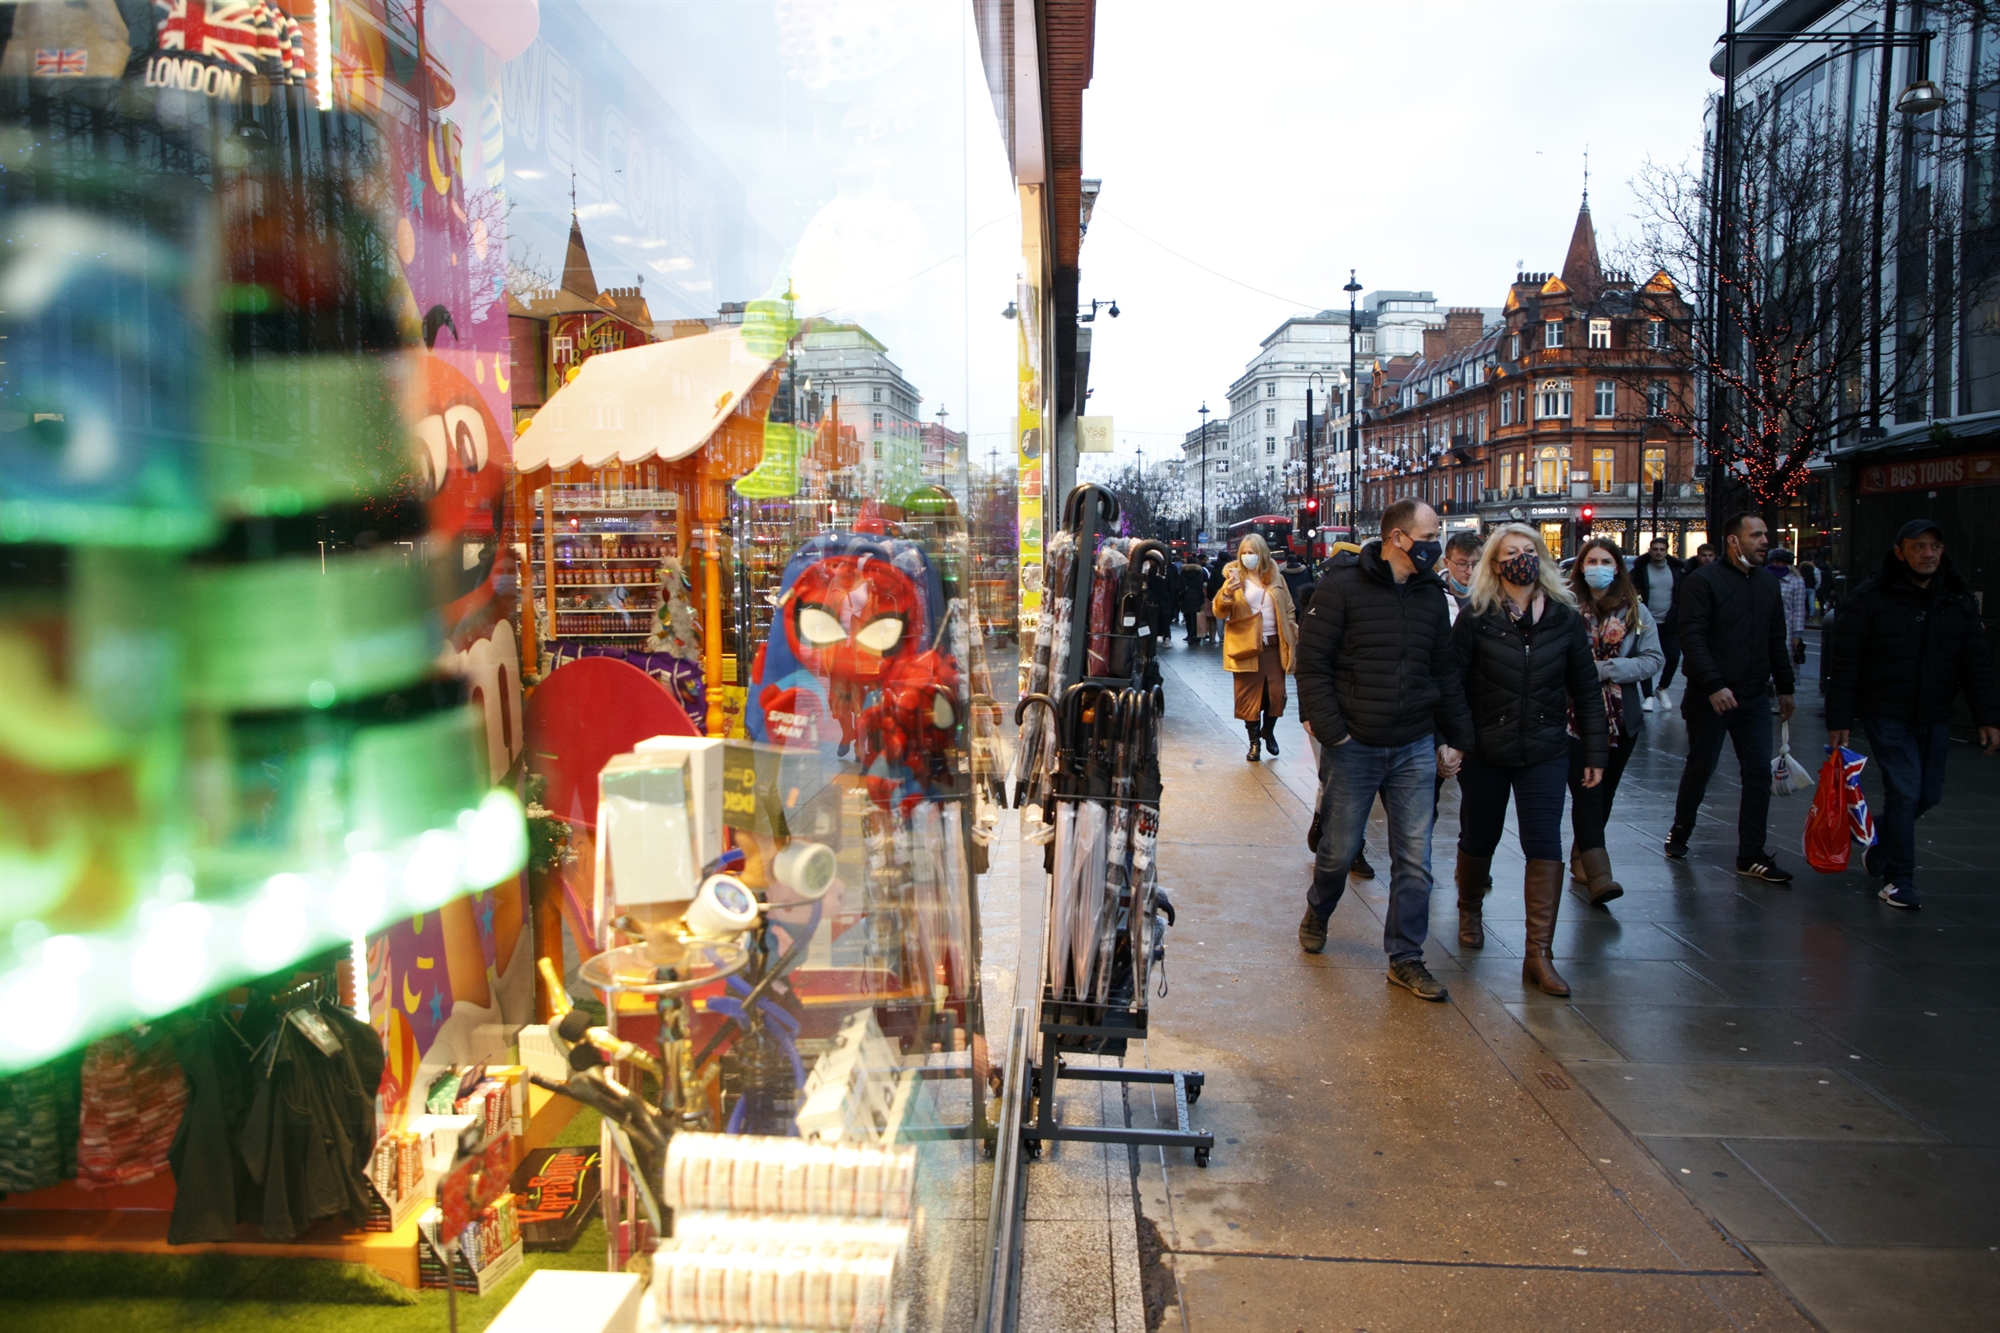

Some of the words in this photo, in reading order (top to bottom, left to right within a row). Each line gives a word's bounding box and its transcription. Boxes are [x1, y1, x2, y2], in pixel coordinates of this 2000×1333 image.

[144, 55, 243, 103] LONDON
[577, 315, 626, 352] Jelly
[1891, 464, 1917, 487] BUS
[1918, 459, 1964, 484] TOURS
[767, 710, 809, 726] SPIDER
